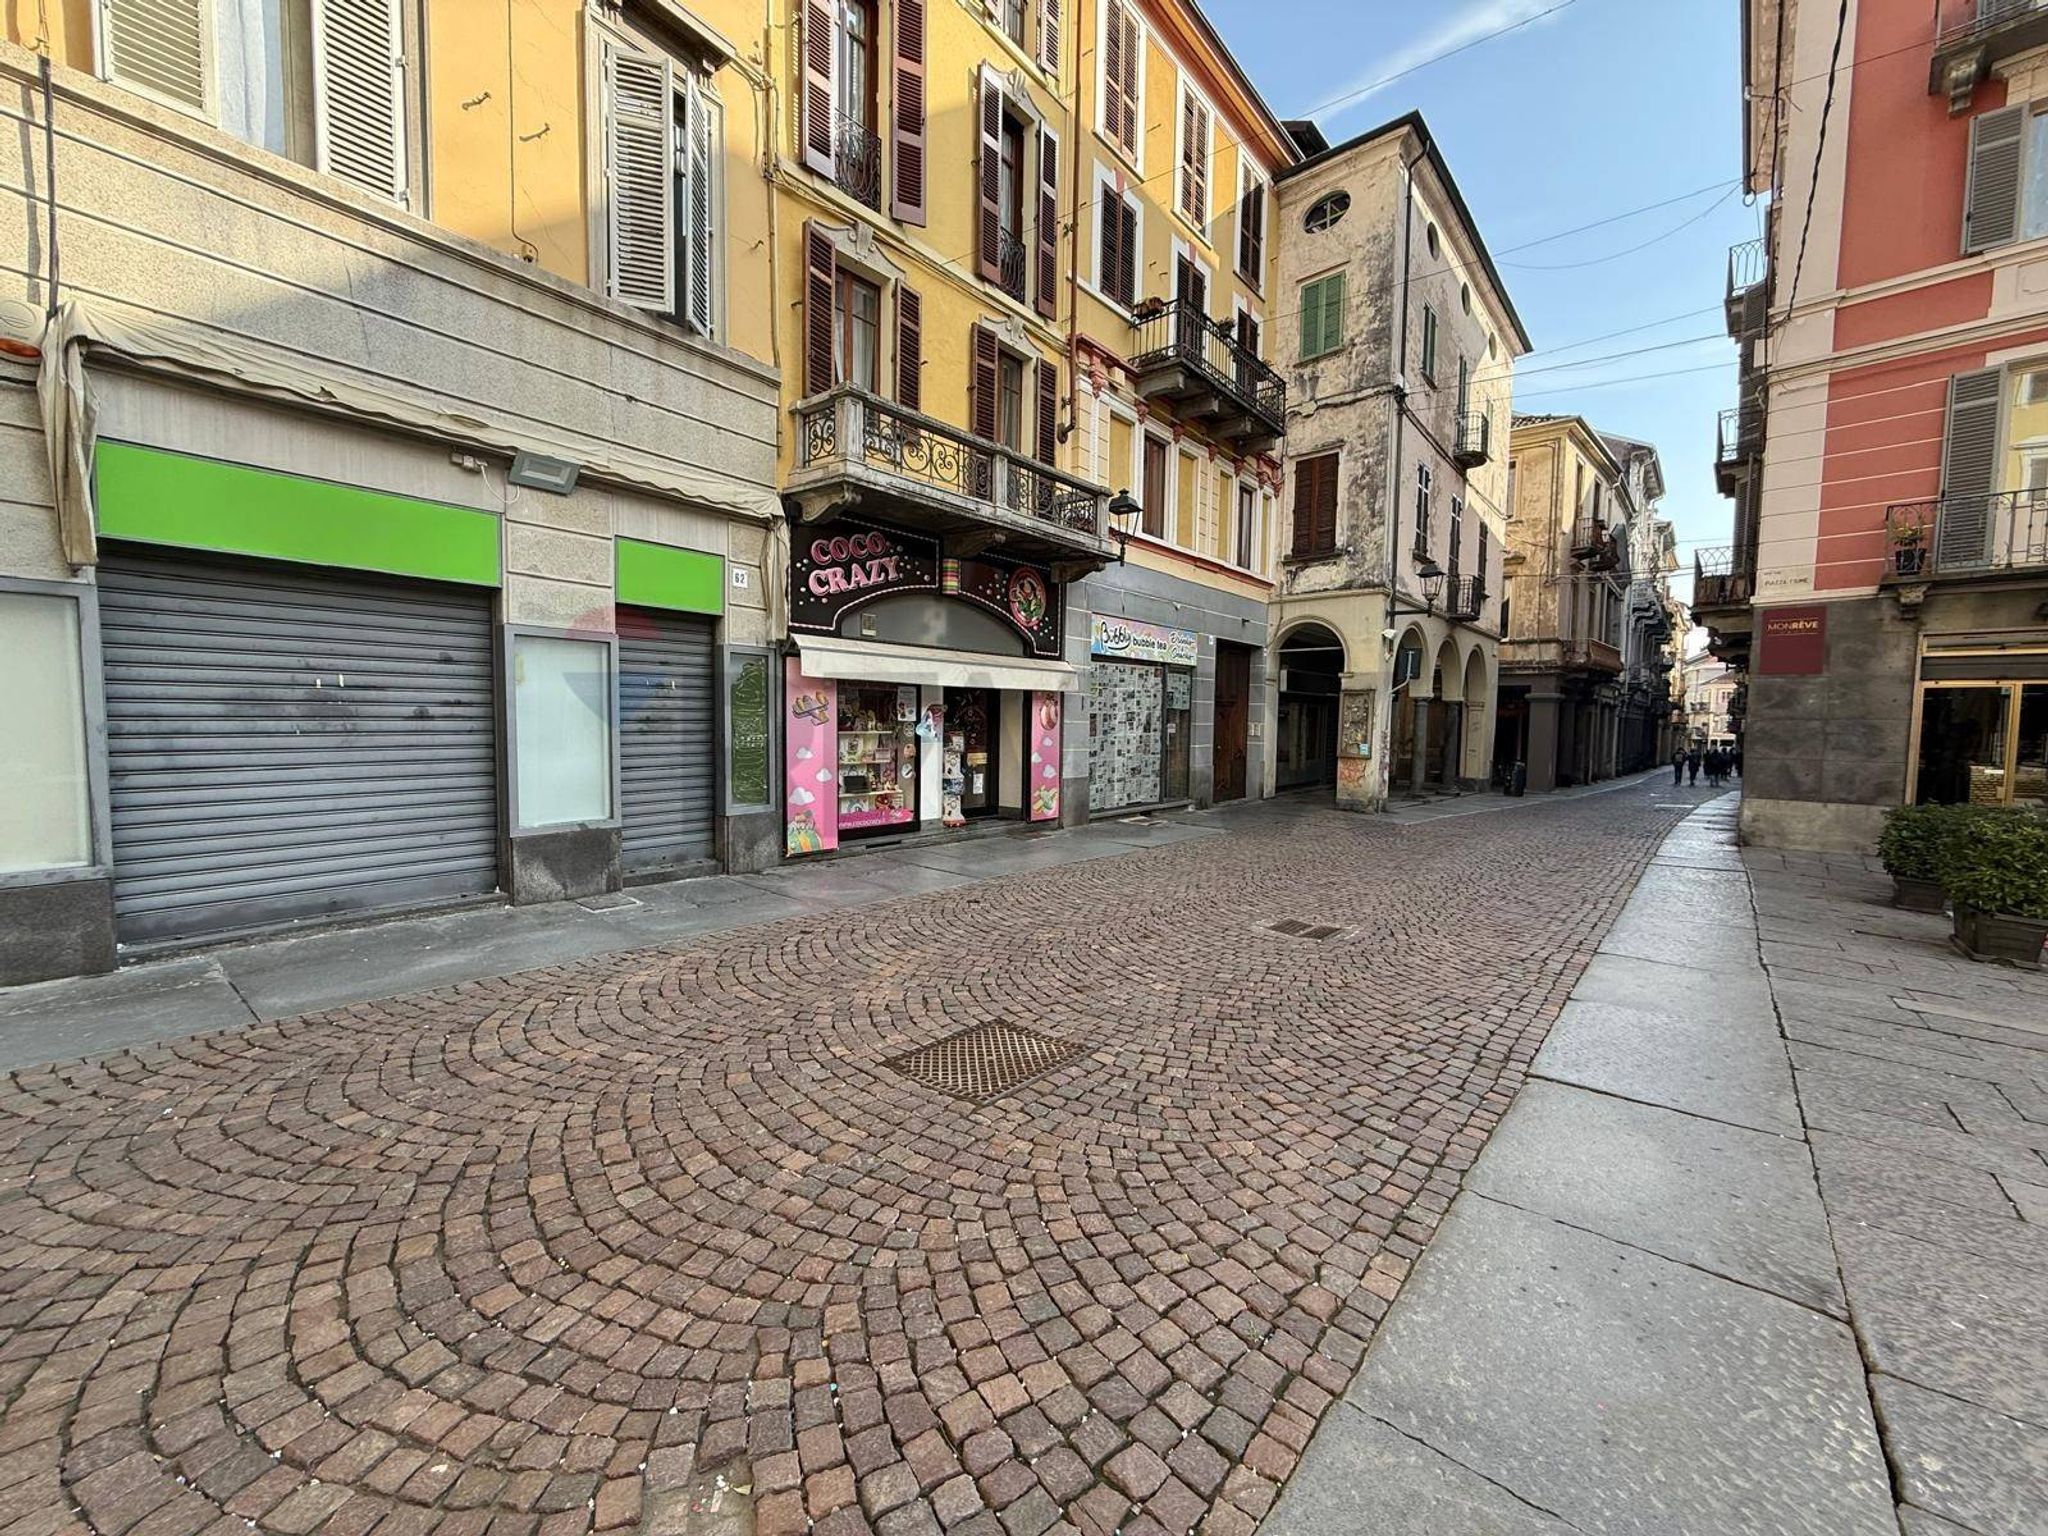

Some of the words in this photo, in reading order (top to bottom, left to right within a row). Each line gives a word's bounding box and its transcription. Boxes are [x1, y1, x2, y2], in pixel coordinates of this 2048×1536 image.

[811, 531, 886, 565] COCO
[735, 572, 745, 584] 62
[808, 555, 900, 596] CRAZY
[1133, 636, 1156, 649] bubble
[1156, 640, 1167, 650] tea
